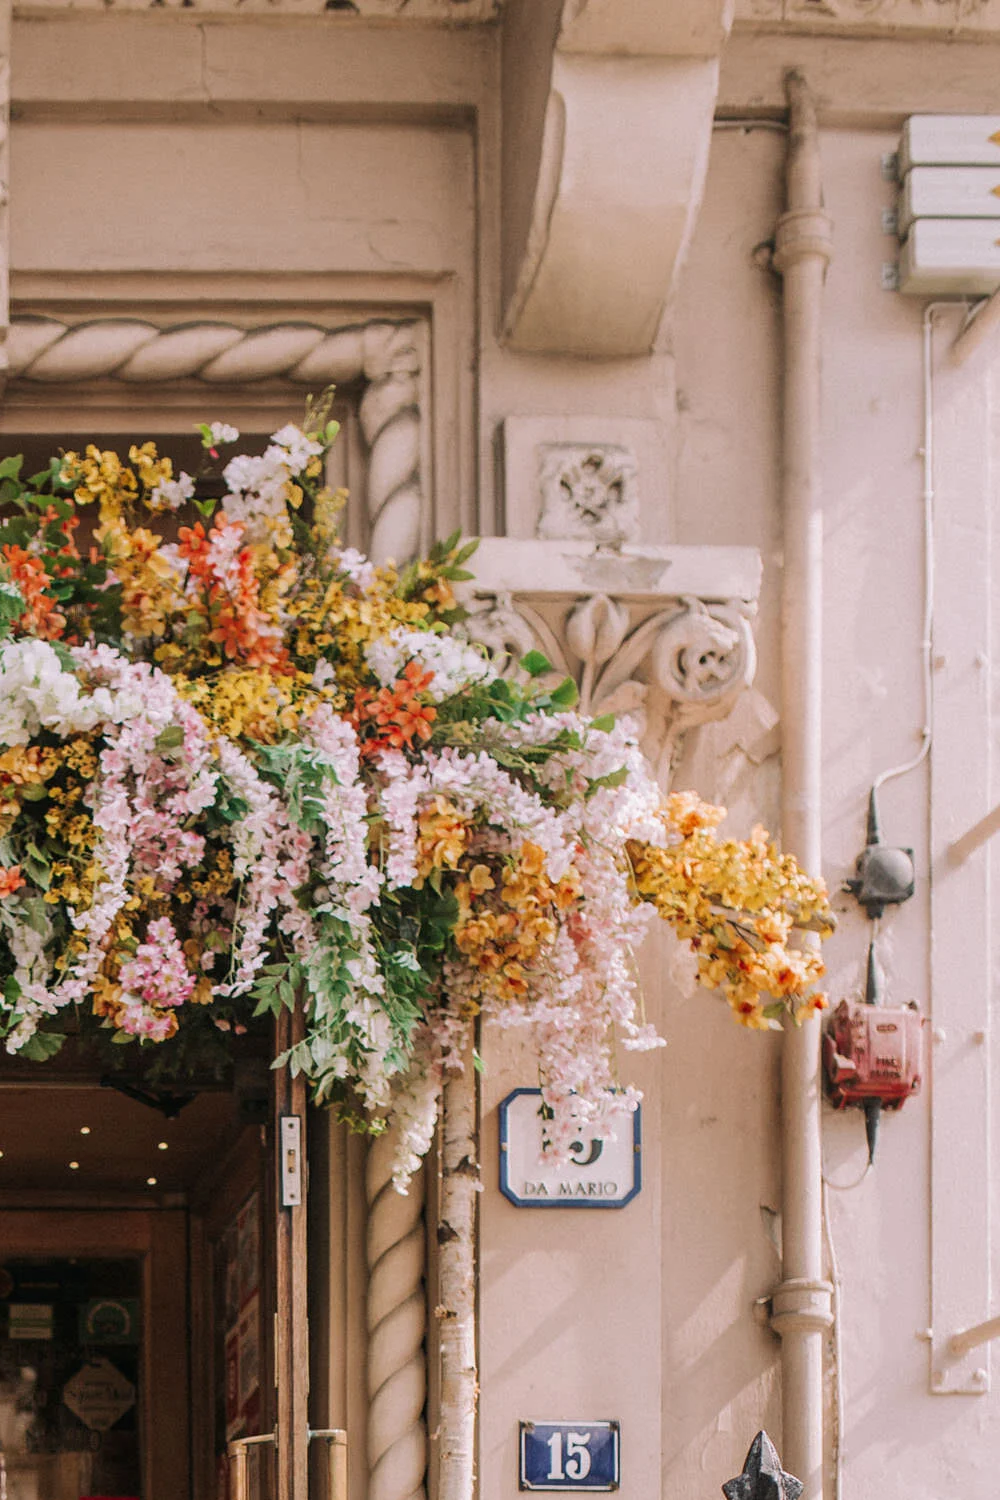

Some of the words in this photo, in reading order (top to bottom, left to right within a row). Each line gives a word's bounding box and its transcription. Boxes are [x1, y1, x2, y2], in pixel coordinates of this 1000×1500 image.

[524, 1182, 549, 1196] DA
[558, 1181, 618, 1196] MARIO
[546, 1431, 592, 1480] 15
